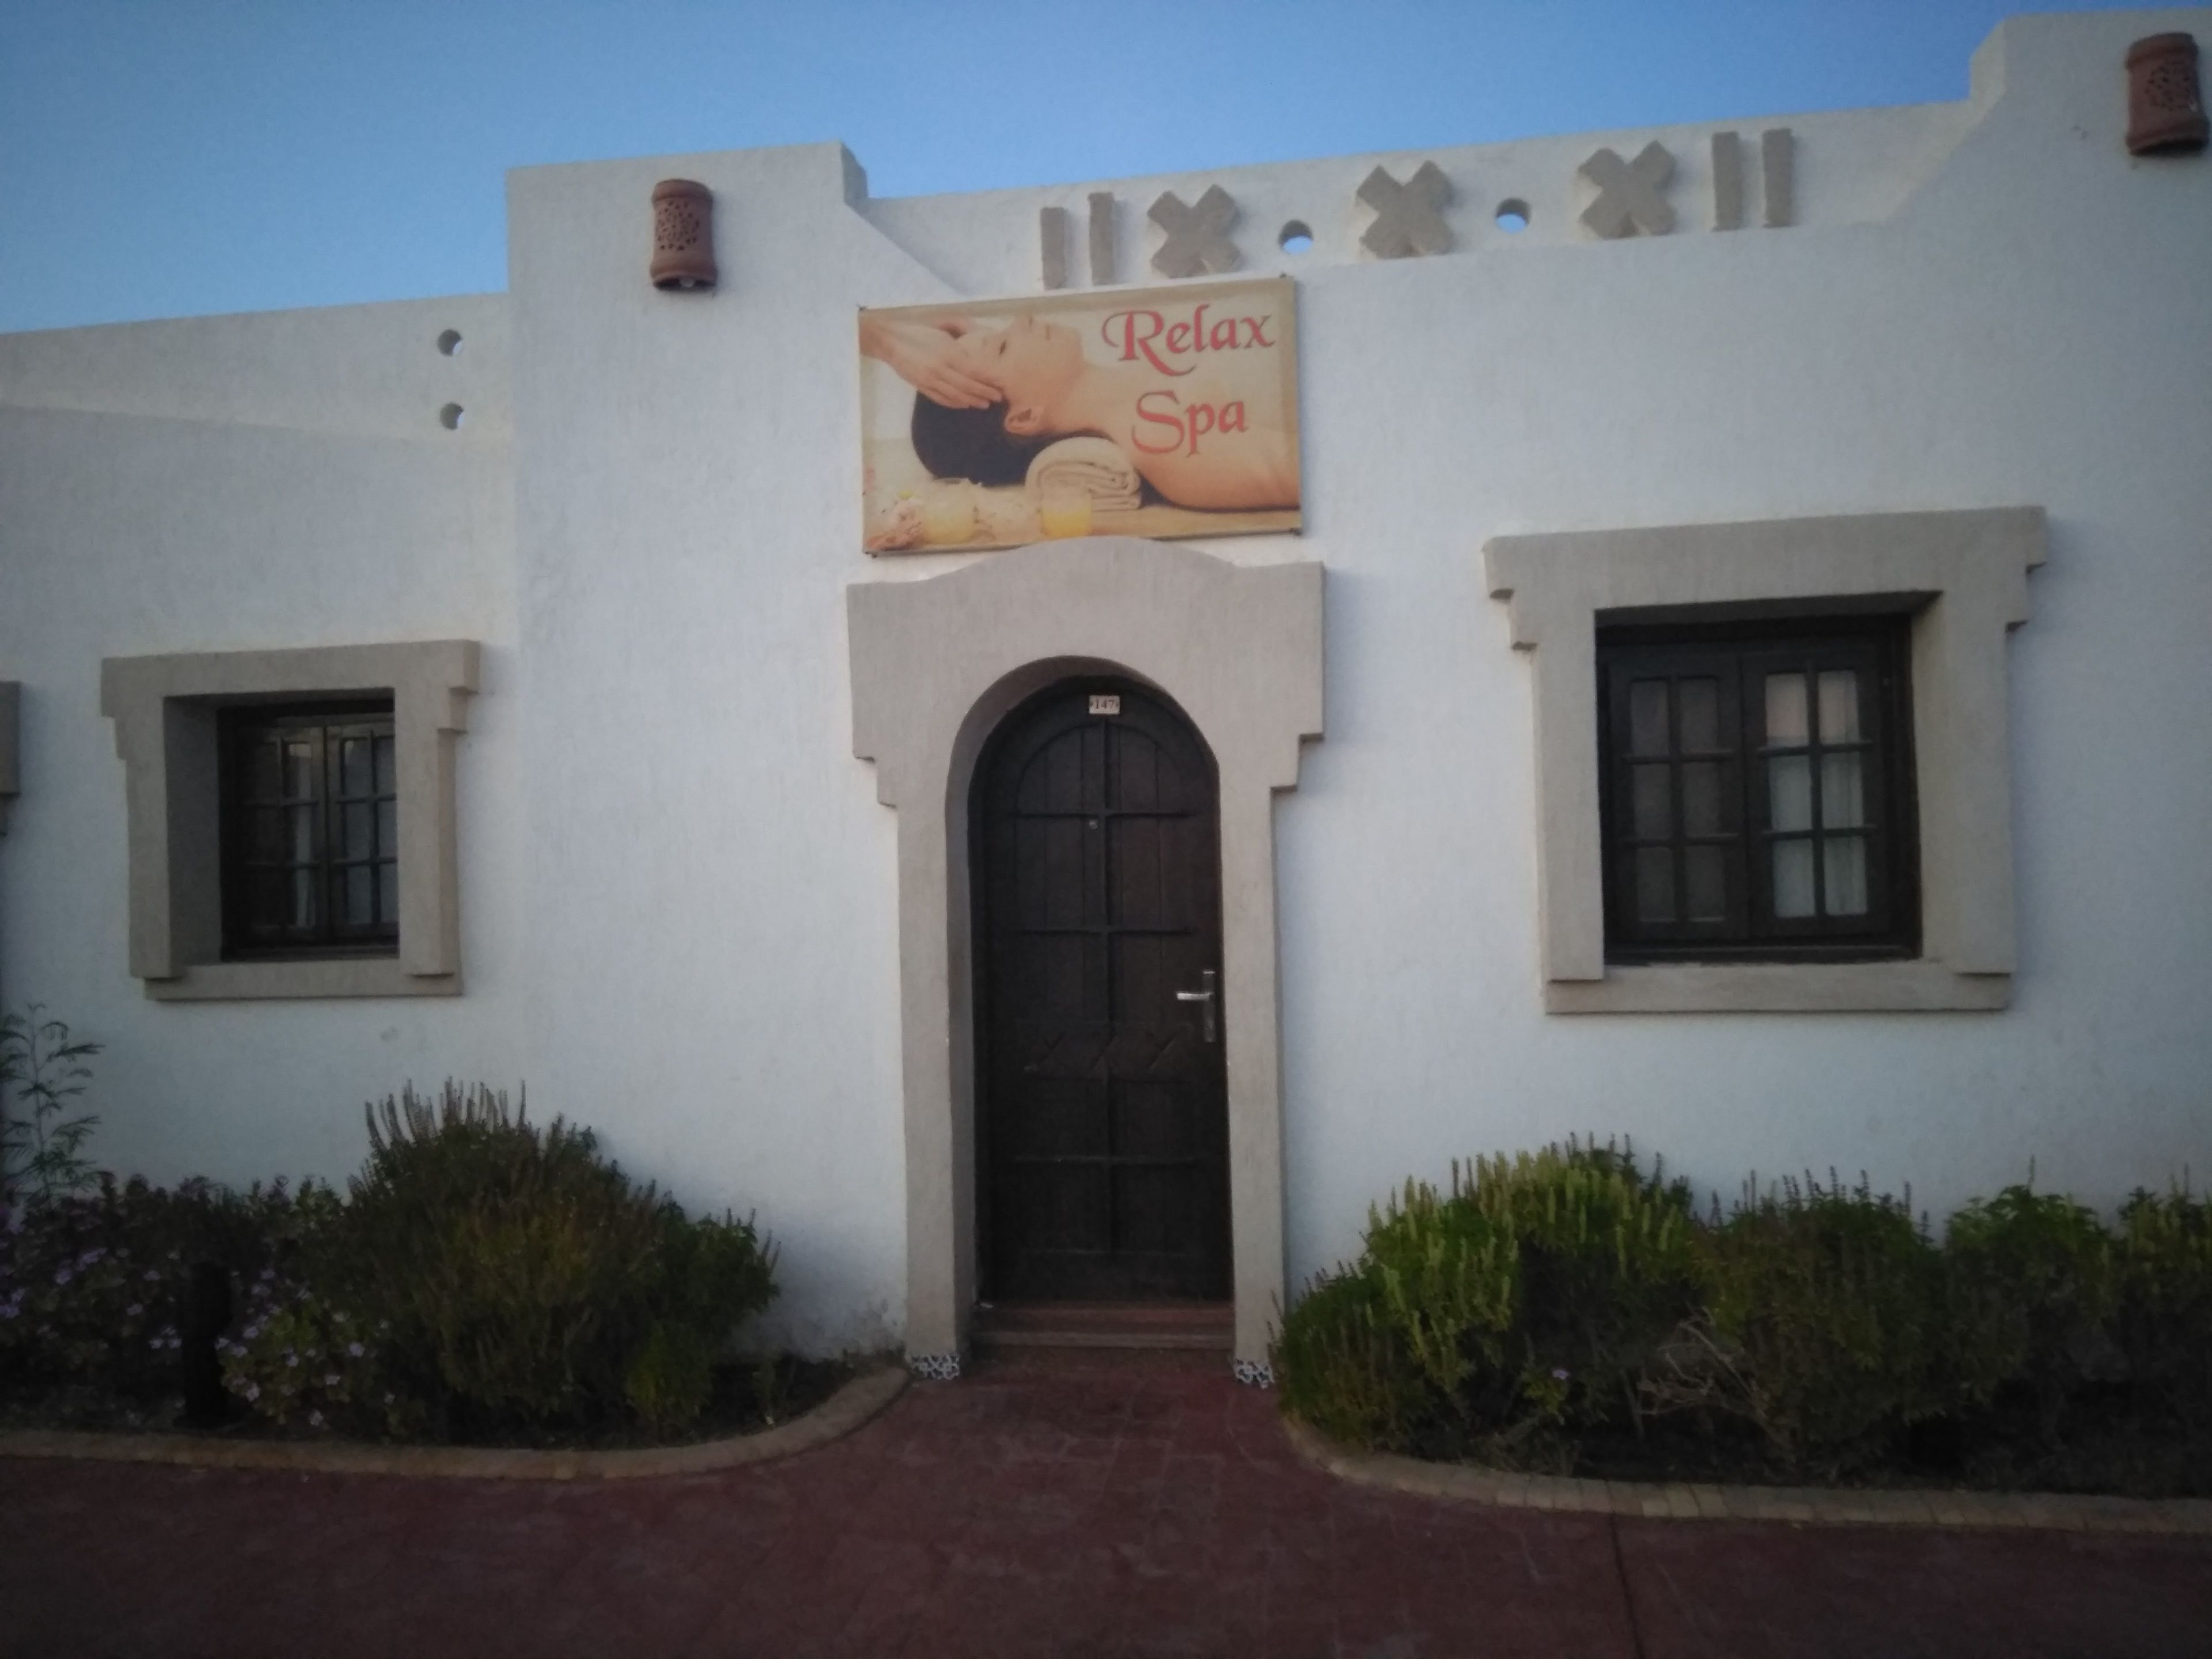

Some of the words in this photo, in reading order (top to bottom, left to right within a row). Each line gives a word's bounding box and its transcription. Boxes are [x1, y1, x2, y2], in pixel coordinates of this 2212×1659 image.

[1101, 304, 1275, 377] Relax
[1131, 390, 1249, 458] Spa
[1093, 698, 1115, 710] 147
